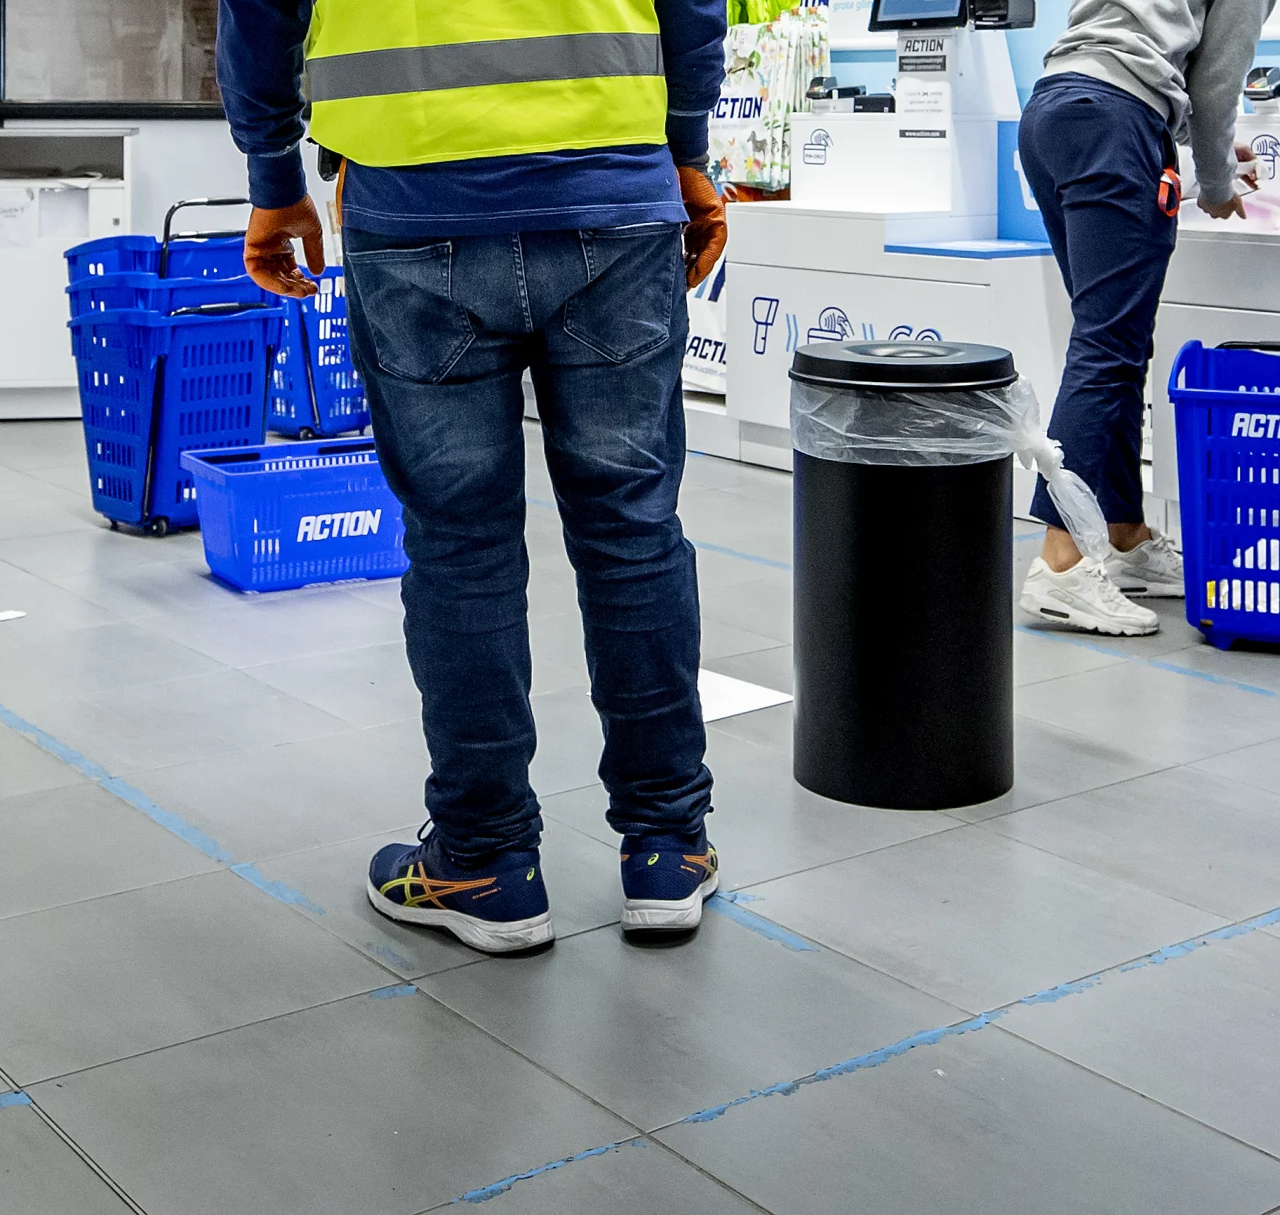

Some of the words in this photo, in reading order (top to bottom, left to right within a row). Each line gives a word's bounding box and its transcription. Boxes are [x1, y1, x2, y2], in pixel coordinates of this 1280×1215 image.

[833, 1, 855, 12] grote
[905, 39, 944, 52] ACTION
[296, 509, 380, 542] ACTION
